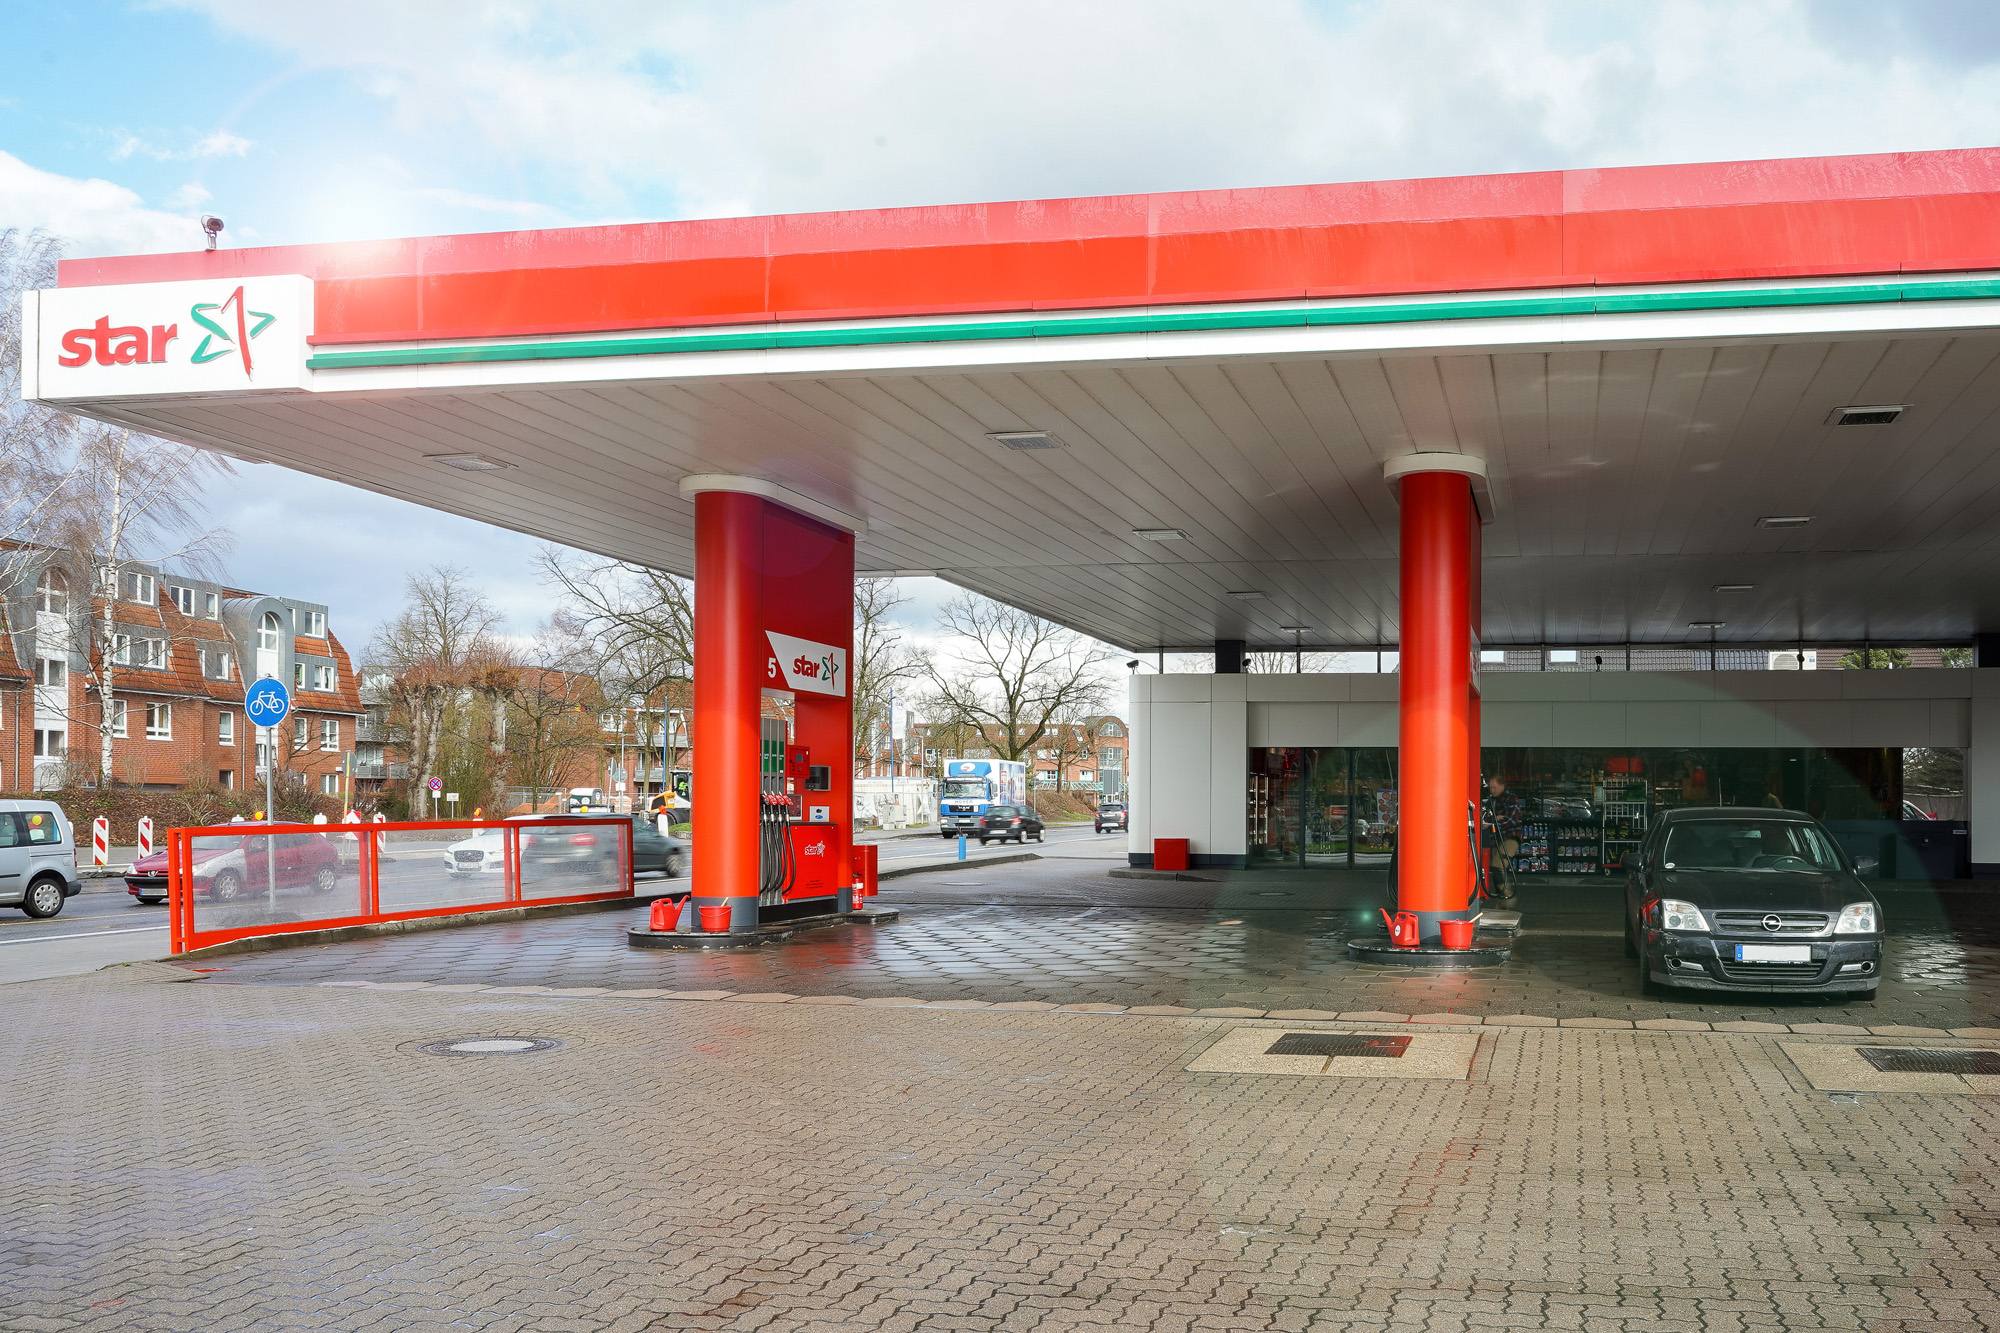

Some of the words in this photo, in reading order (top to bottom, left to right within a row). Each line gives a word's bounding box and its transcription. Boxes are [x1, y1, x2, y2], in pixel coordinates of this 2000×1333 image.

[58, 315, 179, 367] star
[768, 657, 776, 678] 5
[793, 655, 820, 678] star
[804, 844, 818, 856] star
